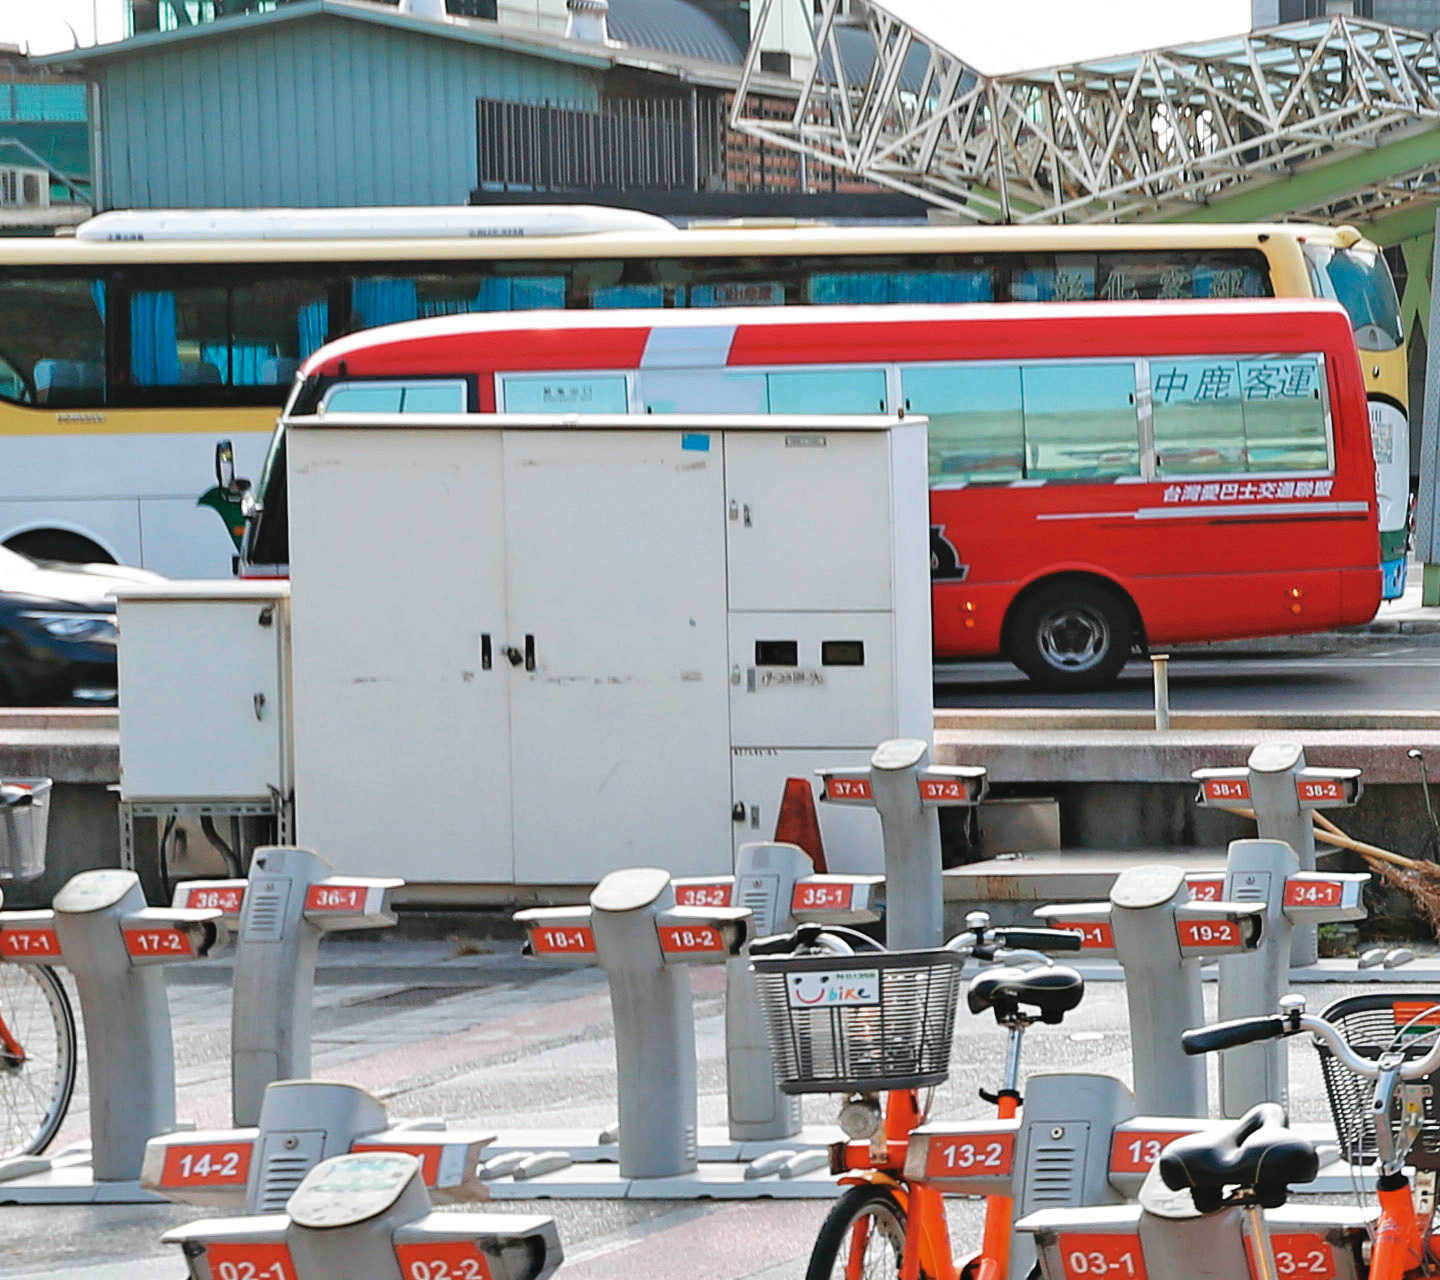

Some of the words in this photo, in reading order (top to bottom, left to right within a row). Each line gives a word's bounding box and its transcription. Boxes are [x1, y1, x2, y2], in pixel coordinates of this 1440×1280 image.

[1155, 363, 1317, 403] 中鹿客運
[1163, 480, 1333, 503] 台灣愛巴士交通聯盟
[835, 783, 864, 795] 37-1
[928, 784, 958, 796] 37-2
[1213, 784, 1241, 795] 38-1
[1306, 785, 1336, 796] 38-2
[196, 892, 238, 908] 36-2
[317, 890, 356, 905] 36-1
[684, 889, 725, 906] 35-2
[804, 889, 842, 904] 35-1
[1296, 887, 1332, 901] 34-1
[545, 932, 584, 947] 18-1
[672, 931, 714, 946] 18-2
[1190, 926, 1231, 940] 19-2
[9, 935, 49, 950] 17-1
[138, 934, 181, 950] 17-2
[944, 1143, 1001, 1167] 13-2
[1129, 1144, 1161, 1163] 13
[181, 1153, 238, 1177] 14-2
[1070, 1252, 1134, 1274] 03-1
[1277, 1251, 1327, 1273] 3-2
